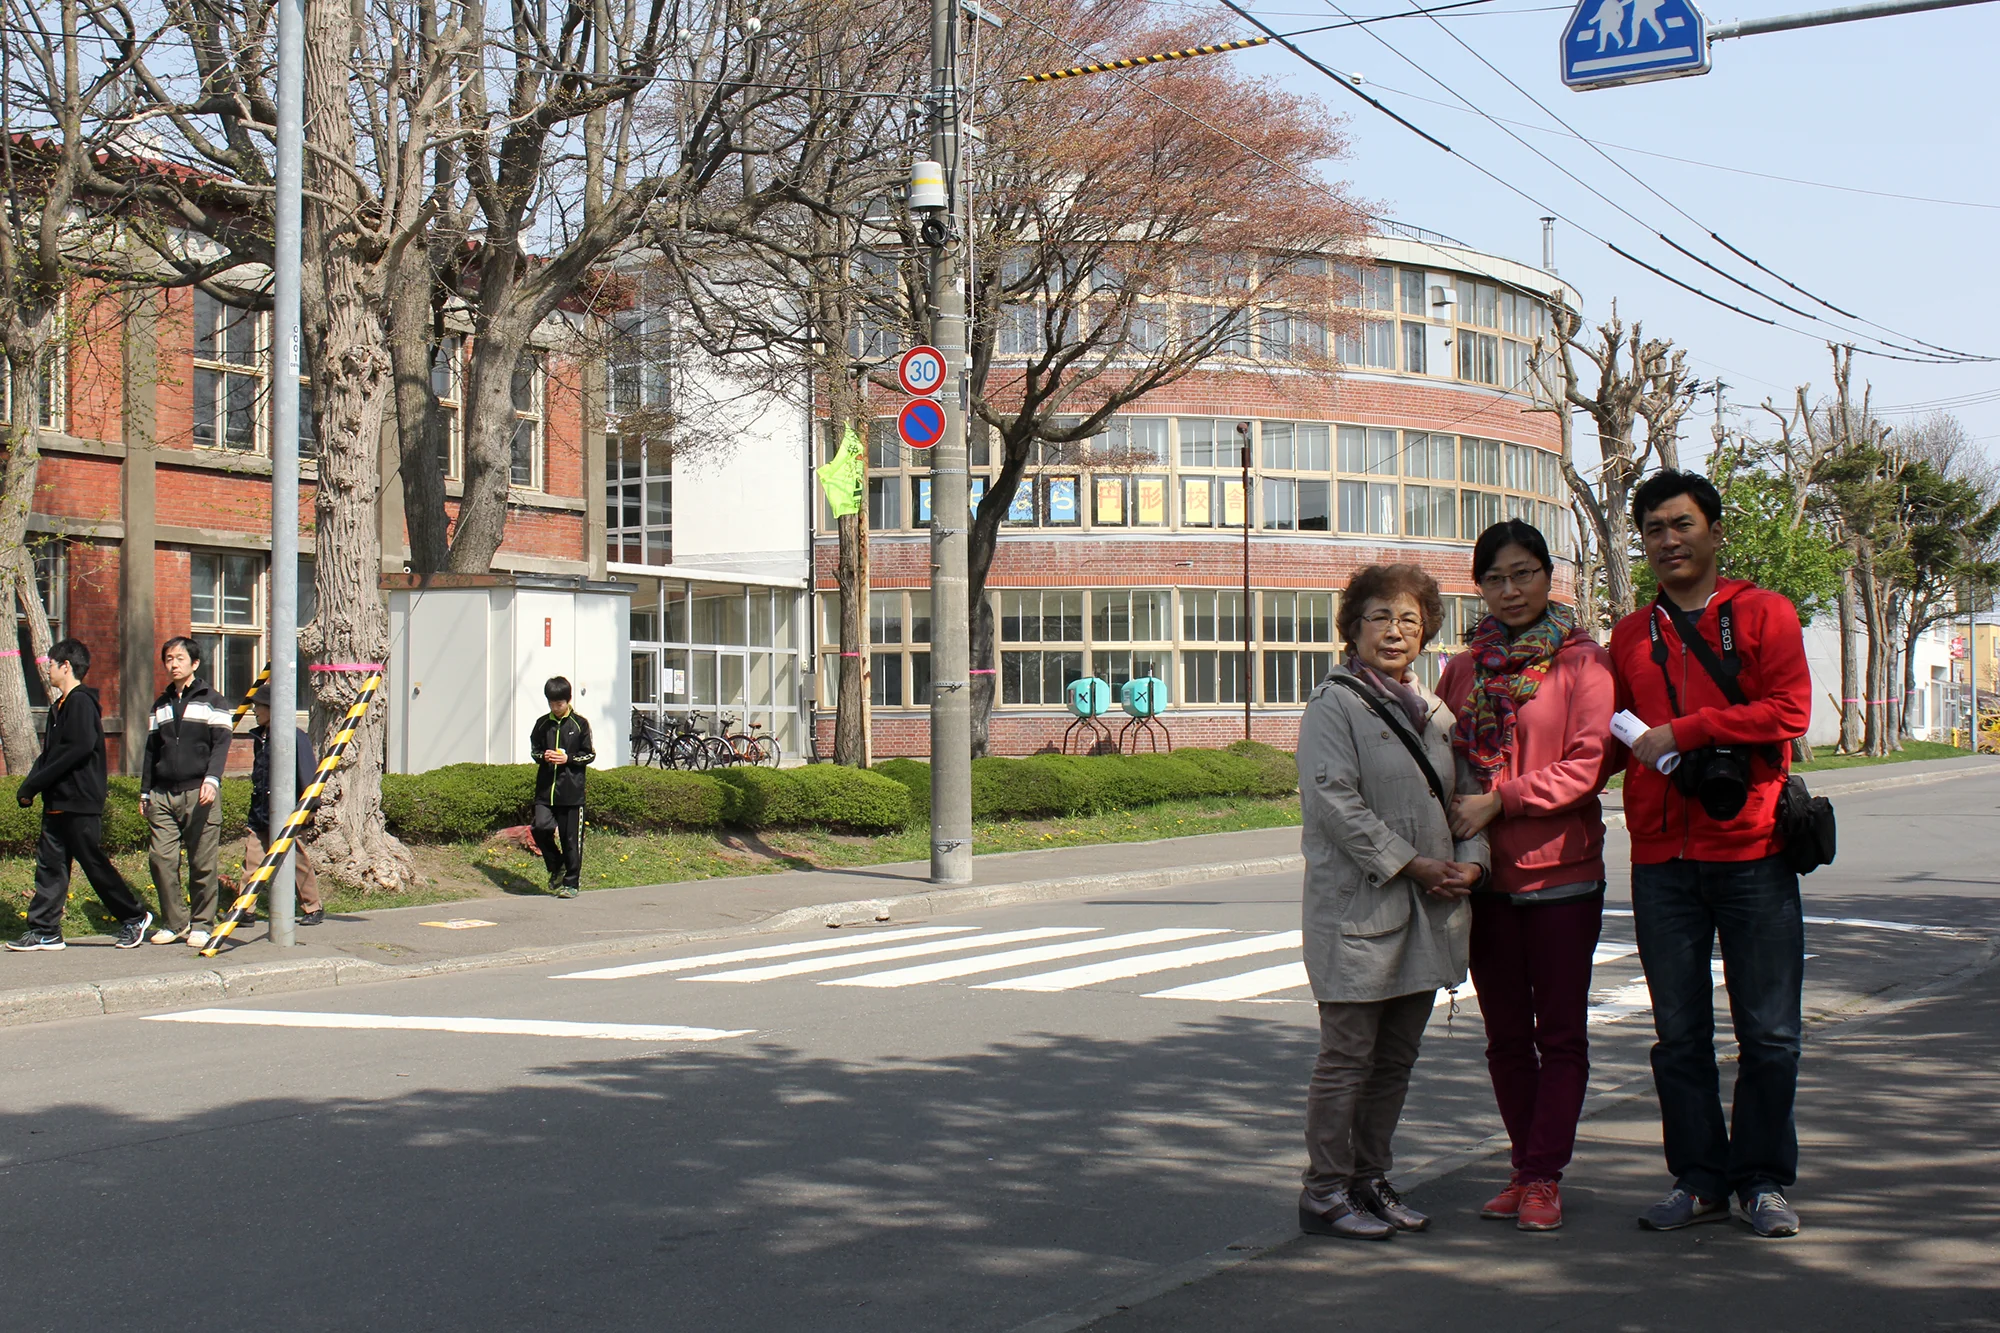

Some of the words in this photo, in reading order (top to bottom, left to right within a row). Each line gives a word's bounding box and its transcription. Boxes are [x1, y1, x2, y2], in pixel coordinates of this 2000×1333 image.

[909, 360, 936, 382] 30
[1720, 616, 1730, 628] 6D
[1721, 628, 1733, 650] EOS
